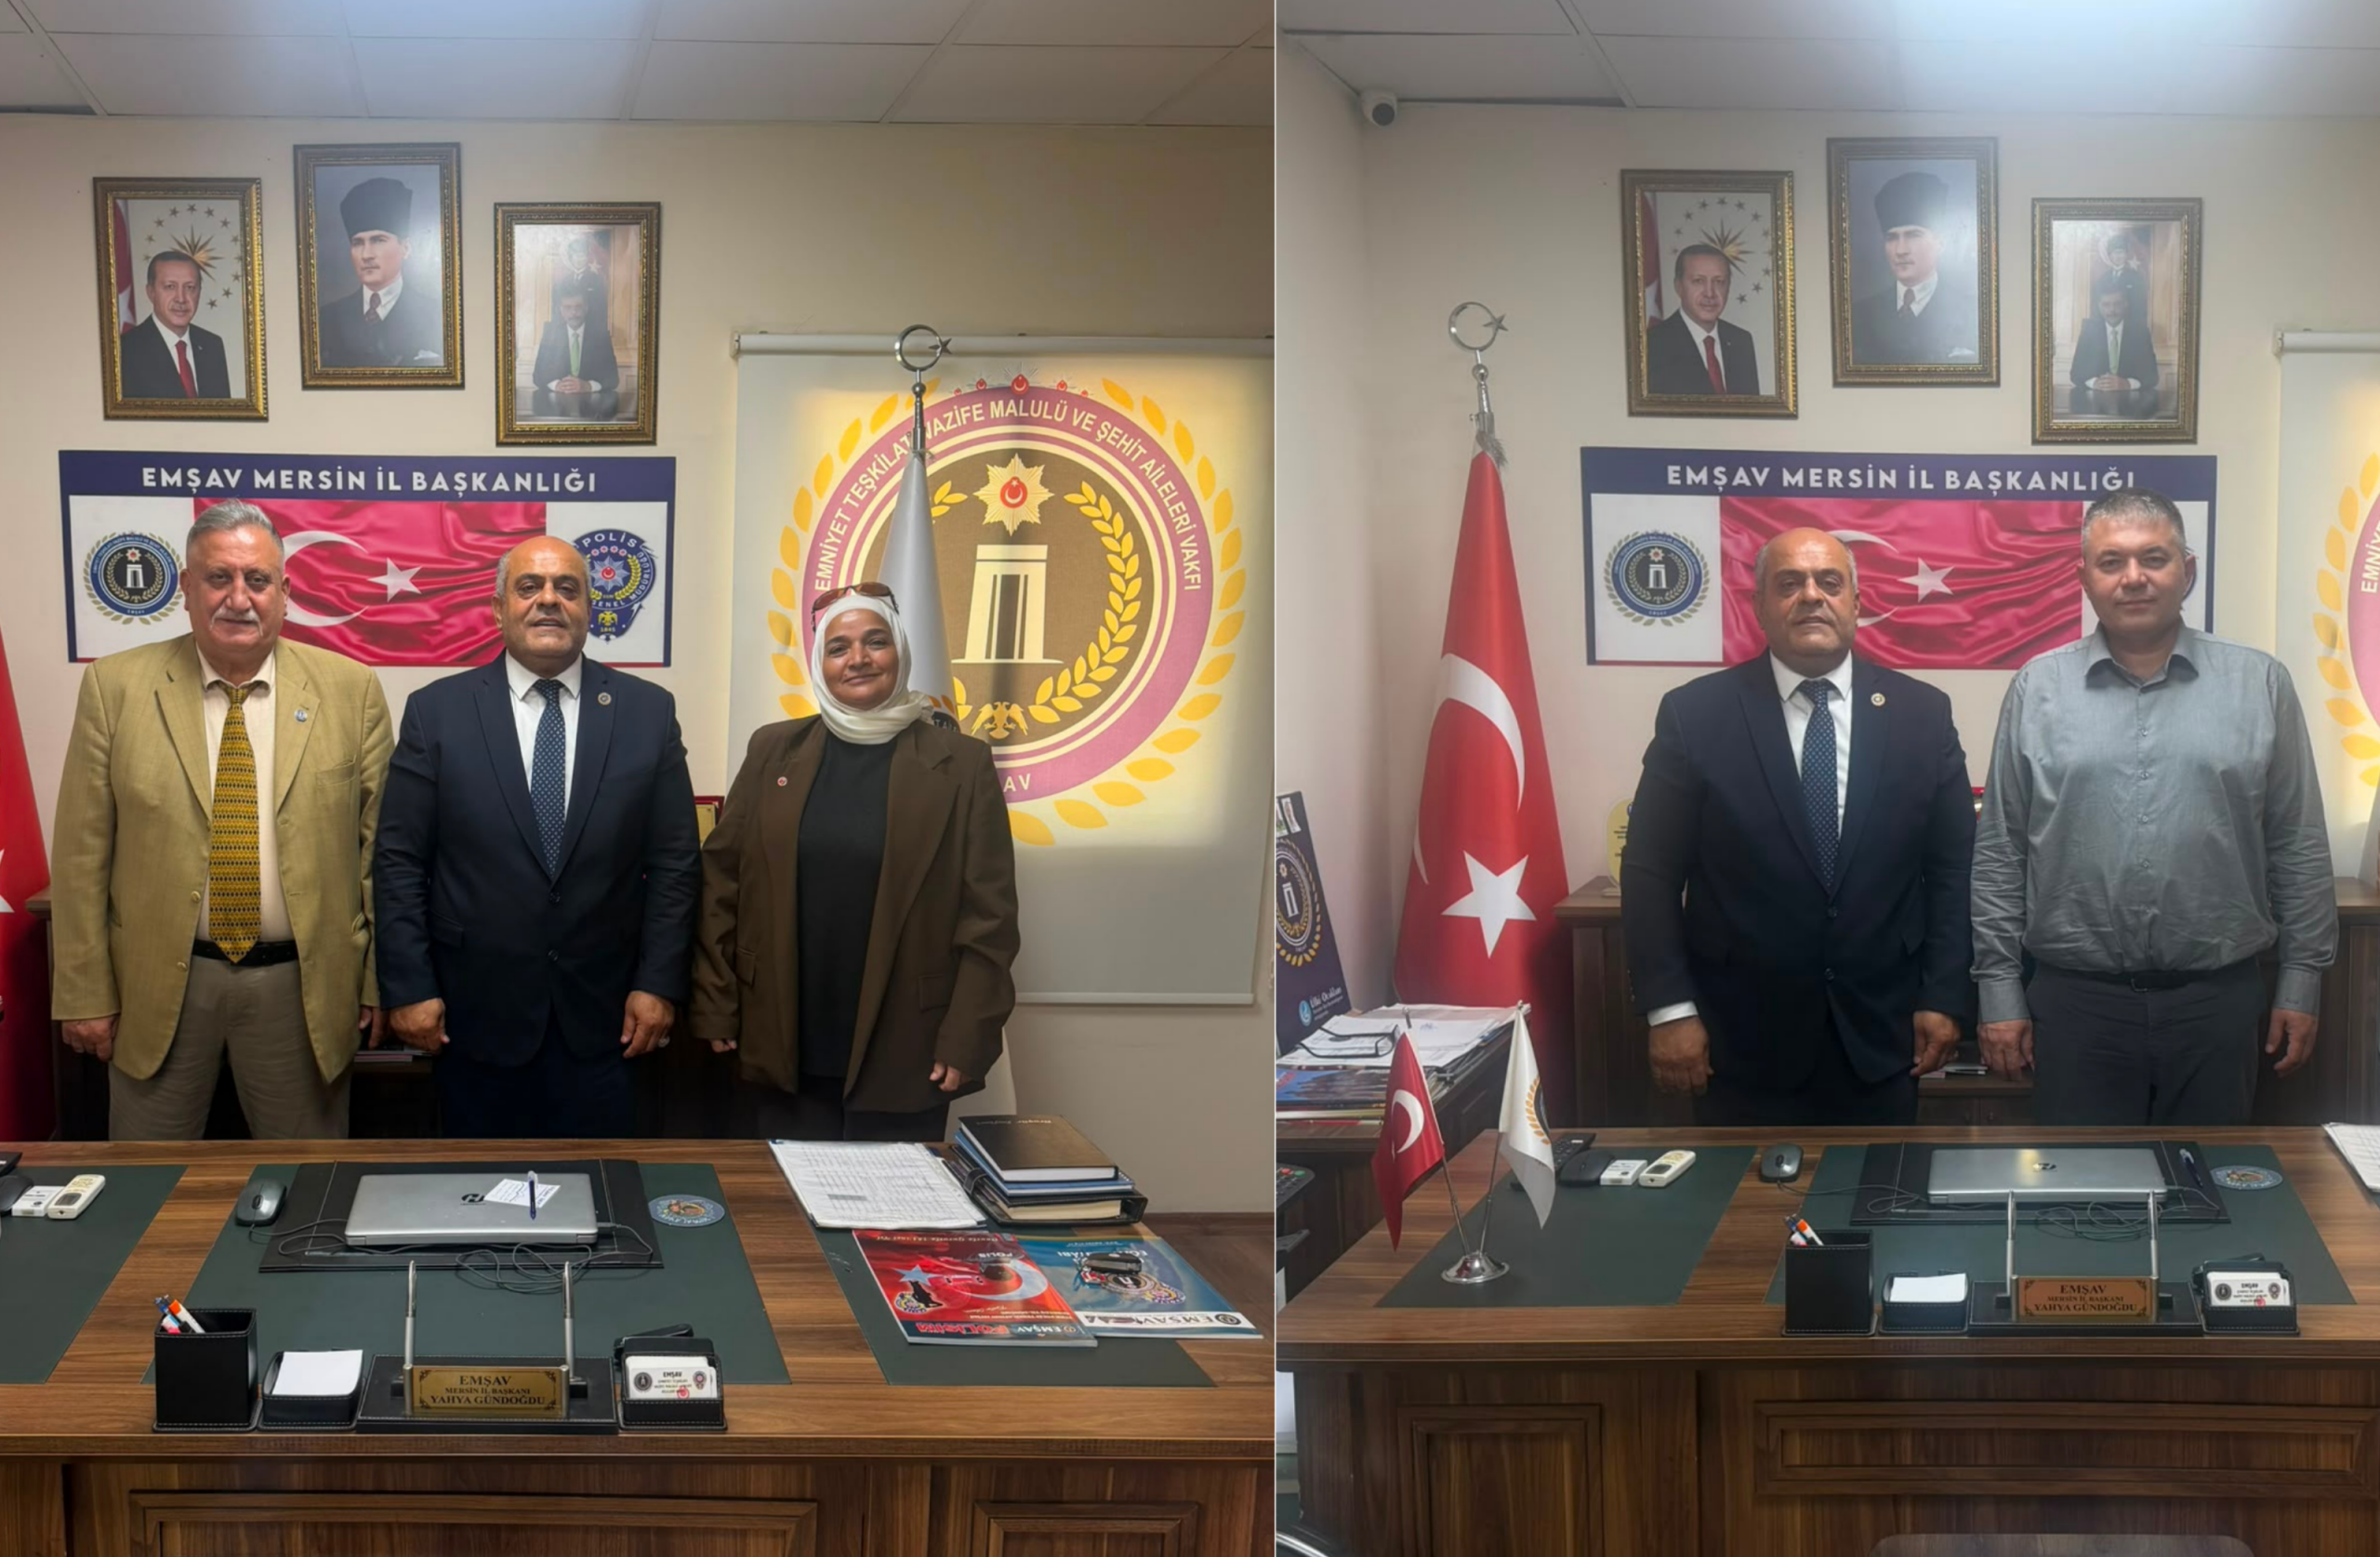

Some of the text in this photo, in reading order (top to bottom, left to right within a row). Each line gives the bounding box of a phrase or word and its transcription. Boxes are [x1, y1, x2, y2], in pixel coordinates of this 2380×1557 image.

[141, 466, 596, 498] EMŞAV MERSİN İL BAŞKANLIĞI
[1667, 464, 2135, 496] EMŞAV MERSİN İL BAŞKANLIĞI
[814, 508, 852, 591] EMNİYET
[842, 435, 912, 508] TEŞKİLAT
[989, 399, 1068, 422] MALULÜ
[1071, 407, 1098, 432] VE
[1095, 420, 1147, 462] ŞEHİT
[1139, 458, 1197, 535] AİLELERİ
[1180, 534, 1202, 590] VAKFI
[582, 532, 638, 548] POLİS
[2059, 1285, 2107, 1296] EMŞAV
[2034, 1302, 2137, 1313] YAHYA GÜNDOĞDU
[459, 1375, 511, 1387] EMŞAV
[430, 1394, 546, 1405] YAHYA GÜNDOĞDU
